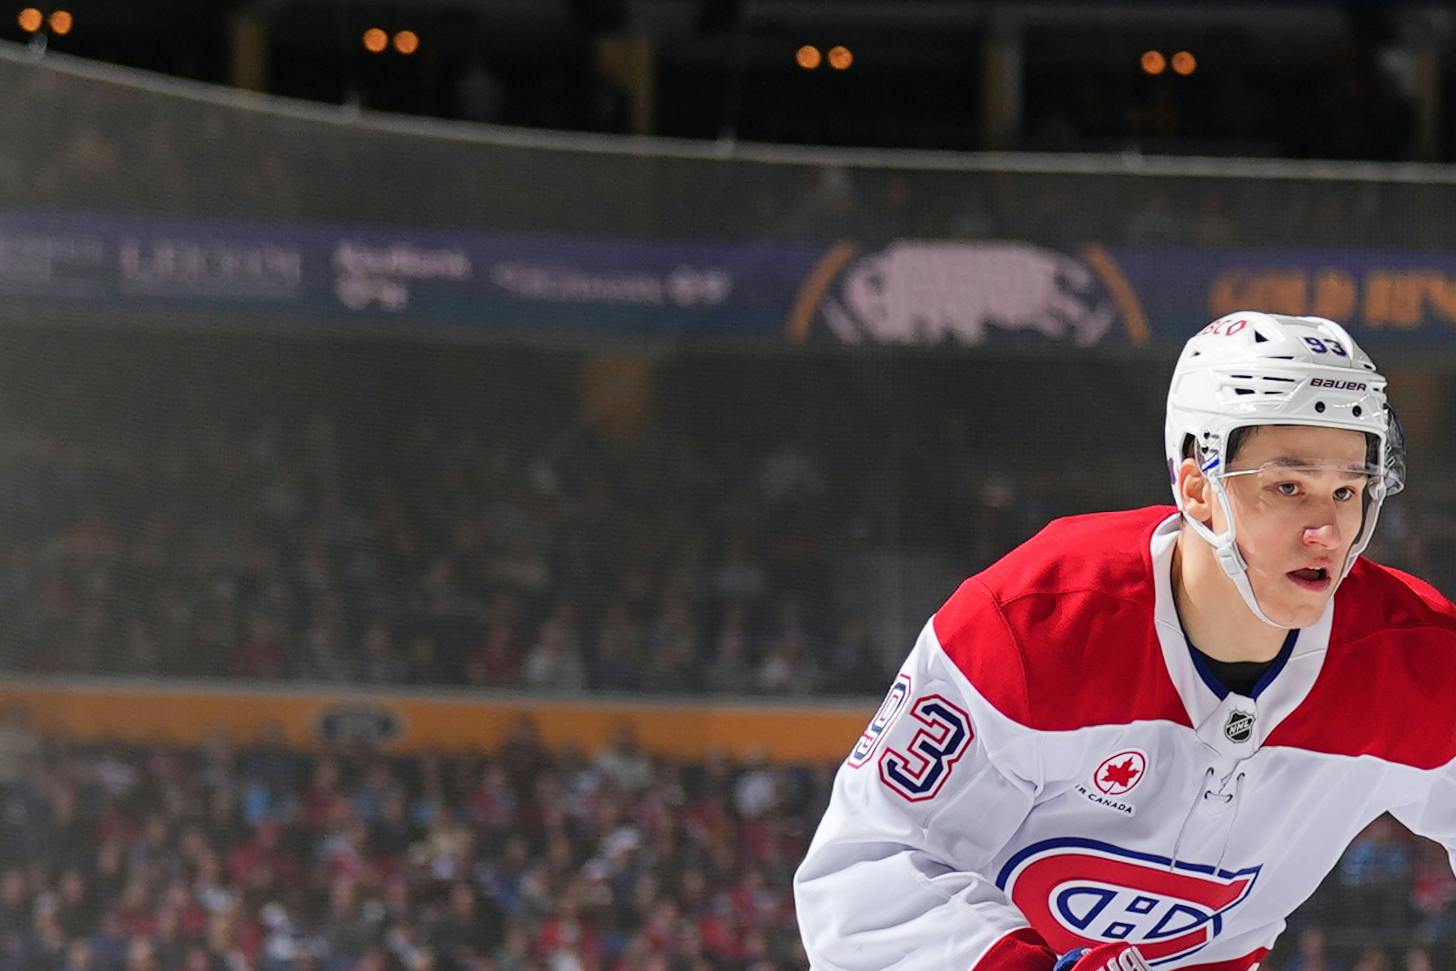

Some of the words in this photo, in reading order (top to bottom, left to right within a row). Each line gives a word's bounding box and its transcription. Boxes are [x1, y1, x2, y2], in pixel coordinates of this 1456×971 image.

[1304, 337, 1347, 357] 93
[1309, 377, 1368, 392] BAUER
[848, 673, 975, 803] 93
[1088, 793, 1133, 814] CANADA
